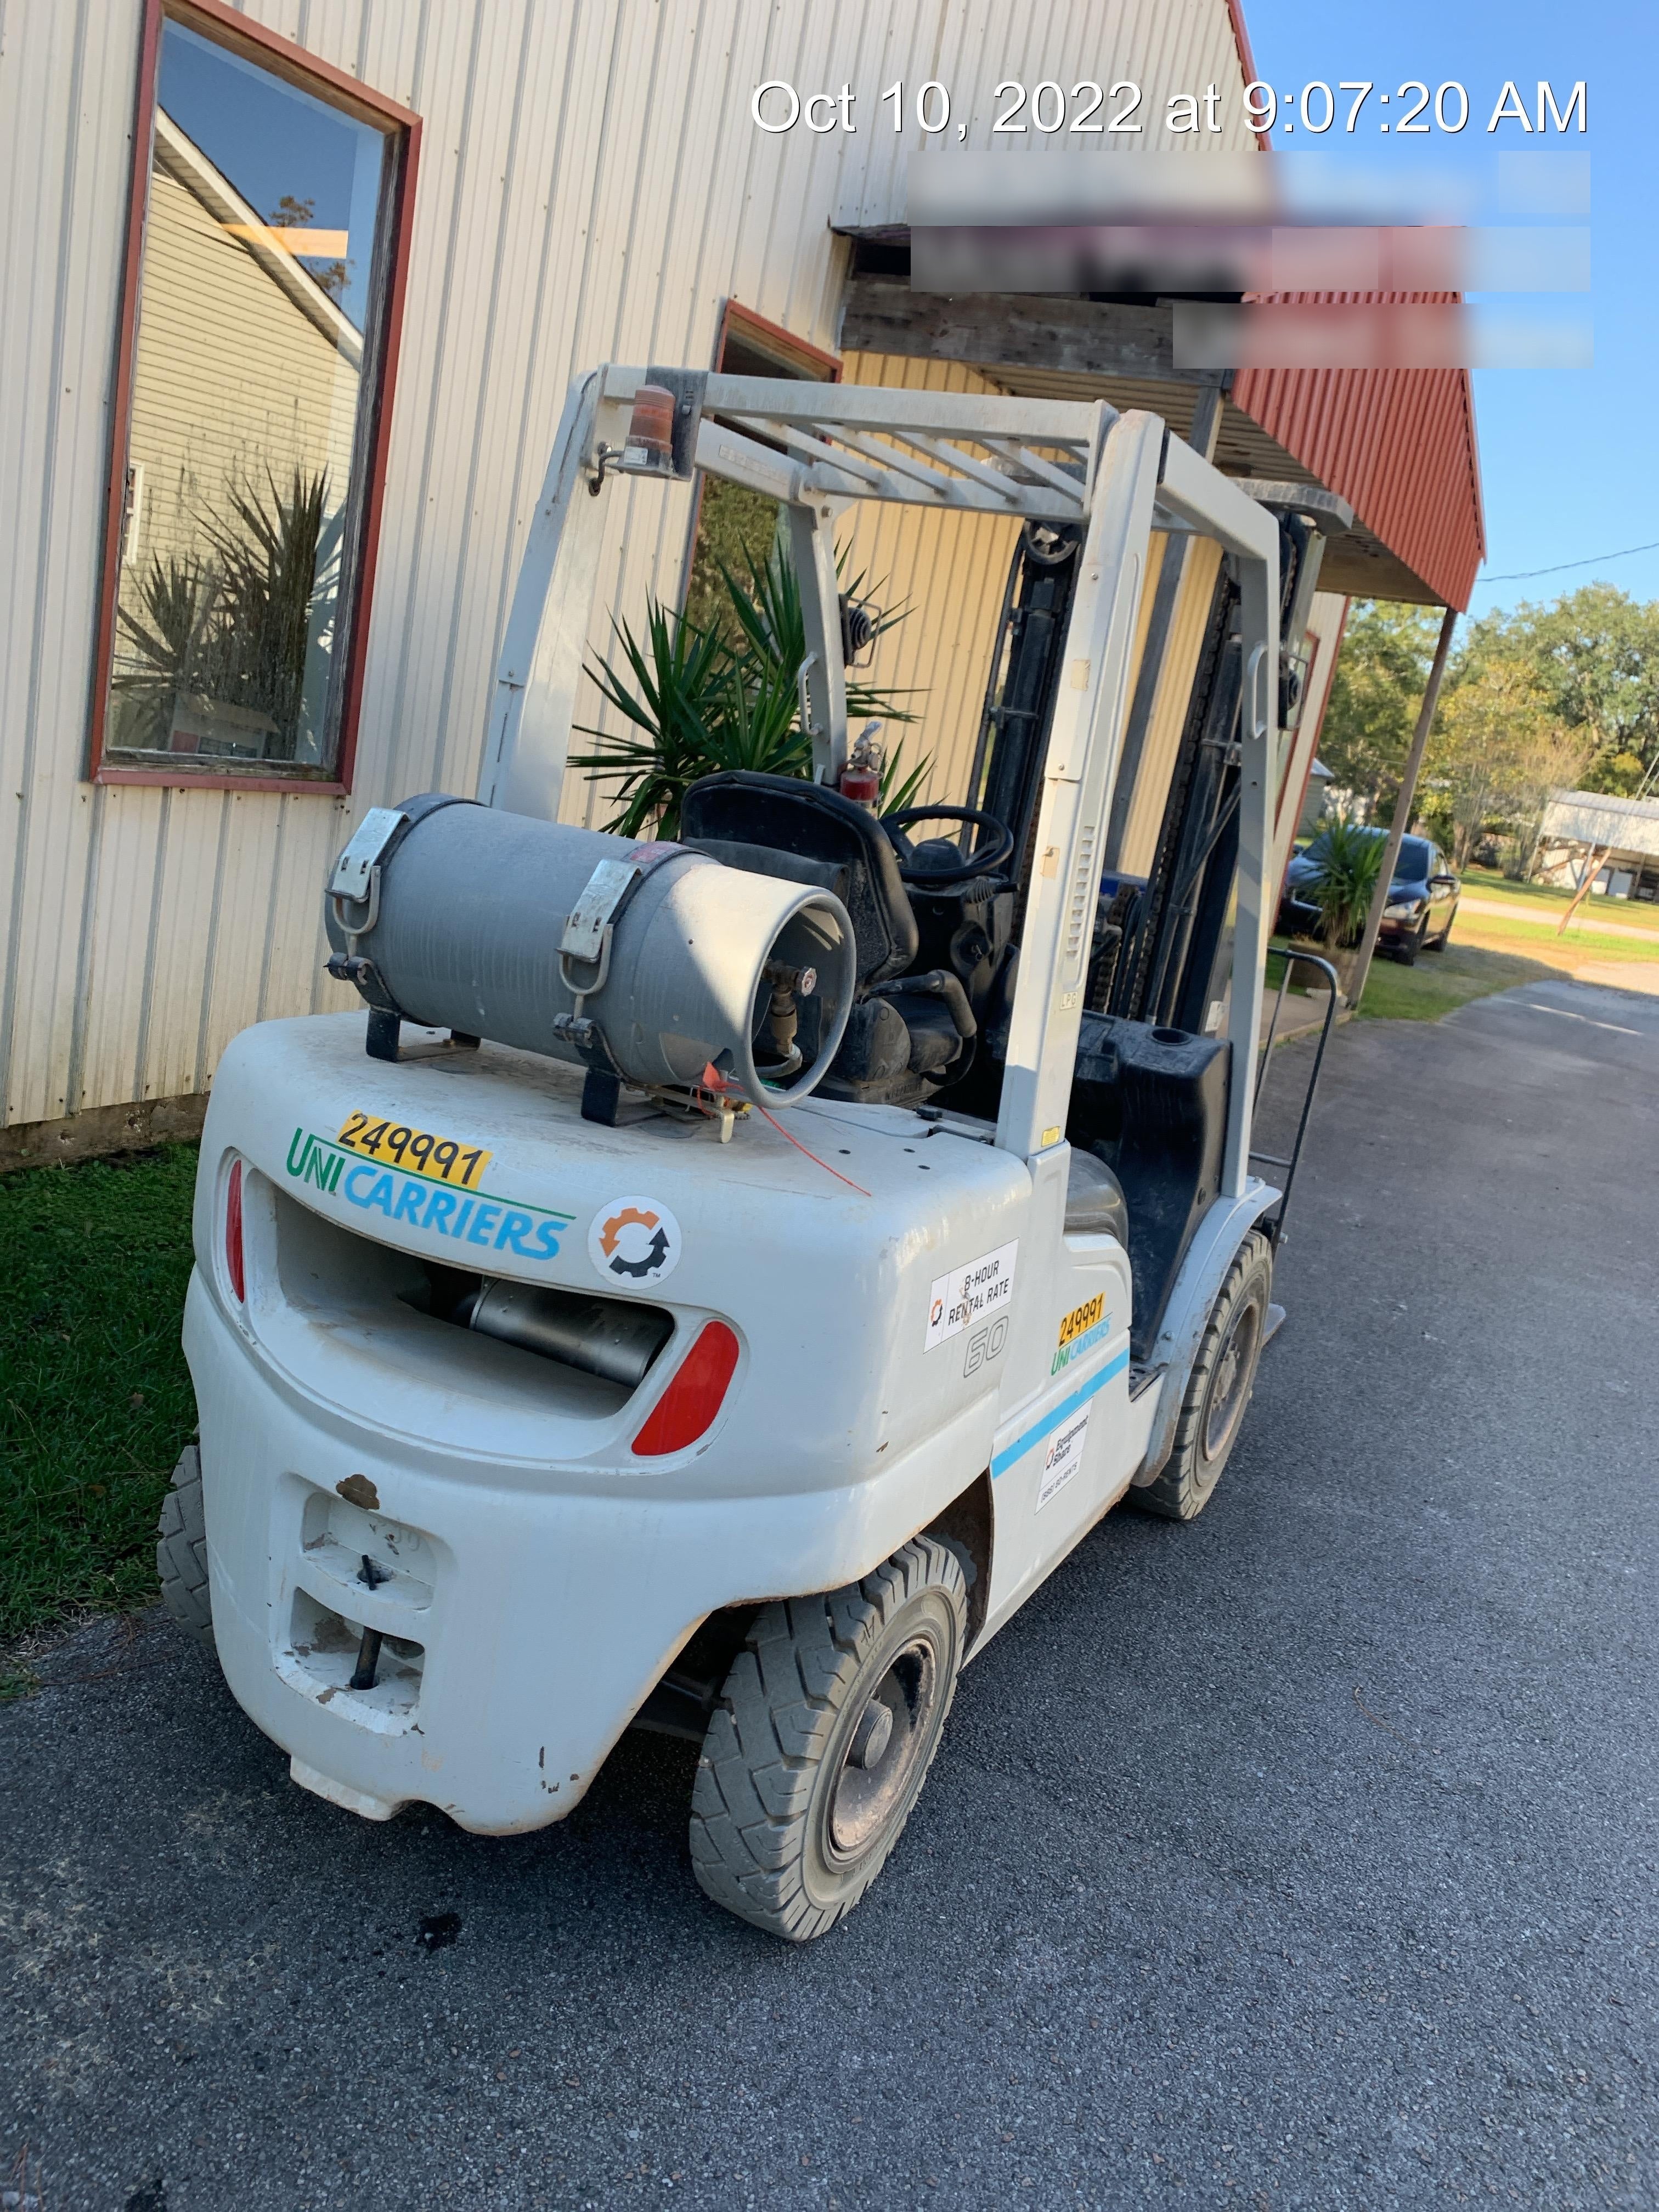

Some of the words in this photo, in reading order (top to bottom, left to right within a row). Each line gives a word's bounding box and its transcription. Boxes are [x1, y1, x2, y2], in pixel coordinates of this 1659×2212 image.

[1062, 993, 1076, 1006] LPG
[337, 1113, 483, 1186] 249991
[286, 1127, 568, 1261] UNICARRIERS
[948, 1292, 984, 1326] RENTAL
[987, 1278, 1010, 1304] RATE
[964, 1260, 1000, 1291] 8-HOUR
[963, 1315, 1009, 1379] 60
[1059, 1293, 1103, 1347] 249991
